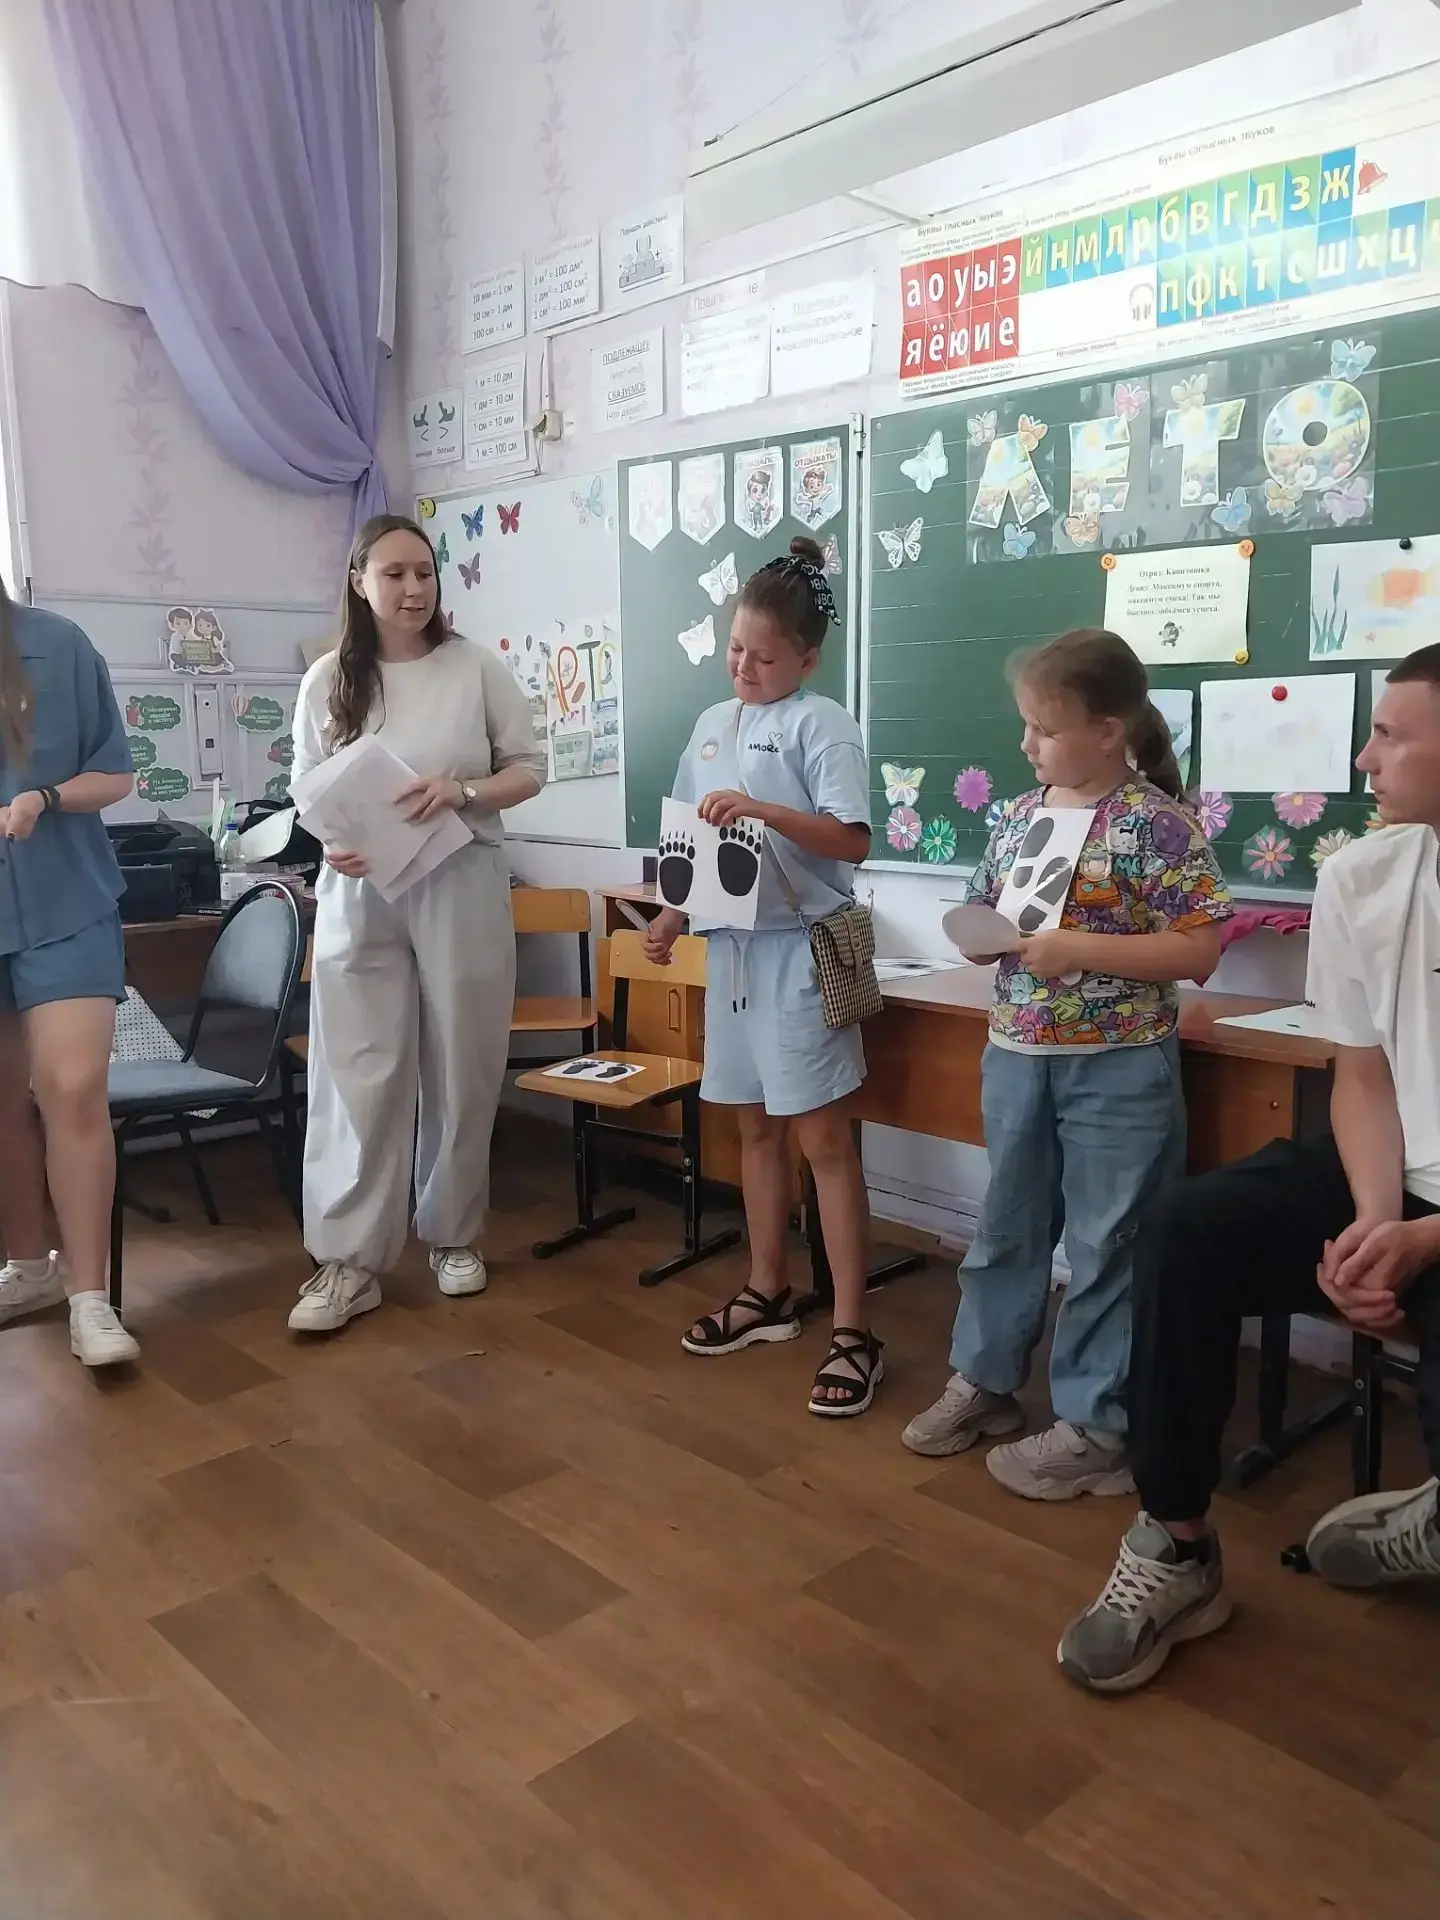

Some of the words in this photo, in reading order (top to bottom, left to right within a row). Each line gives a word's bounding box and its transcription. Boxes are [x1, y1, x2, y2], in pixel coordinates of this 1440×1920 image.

[1240, 125, 1276, 142] звуков
[1161, 195, 1179, 242] б
[1189, 200, 1209, 237] в
[1222, 191, 1238, 226] г
[1251, 181, 1276, 228] д
[1290, 175, 1311, 211] з
[917, 225, 943, 238] Буквы
[944, 217, 977, 232] гласных
[1025, 237, 1043, 276] й
[1050, 241, 1068, 271] н
[1074, 233, 1097, 263] м
[1102, 226, 1124, 258] л
[1132, 219, 1151, 263] р
[555, 264, 568, 277] 100
[1161, 279, 1180, 312] п
[1186, 264, 1210, 317] ф
[1219, 265, 1237, 299] к
[1254, 257, 1272, 292] т
[1317, 242, 1346, 280] ш
[1357, 232, 1377, 270] х
[1391, 224, 1417, 267] ц
[559, 281, 573, 294] 100
[907, 277, 922, 308] а
[929, 273, 946, 302] о
[952, 264, 971, 307] у
[973, 257, 995, 288] ы
[1001, 253, 1016, 285] э
[472, 291, 481, 304] 10
[558, 297, 572, 312] 100
[473, 309, 481, 322] 10
[473, 326, 485, 341] 100
[905, 334, 922, 367] я
[928, 322, 945, 362] ё
[949, 325, 968, 357] ю
[974, 317, 990, 351] и
[999, 316, 1014, 346] е
[493, 371, 502, 385] 10
[495, 393, 504, 404] 10
[494, 417, 503, 428] 10
[495, 443, 507, 457] 100
[968, 378, 1372, 529] ЛЕТО
